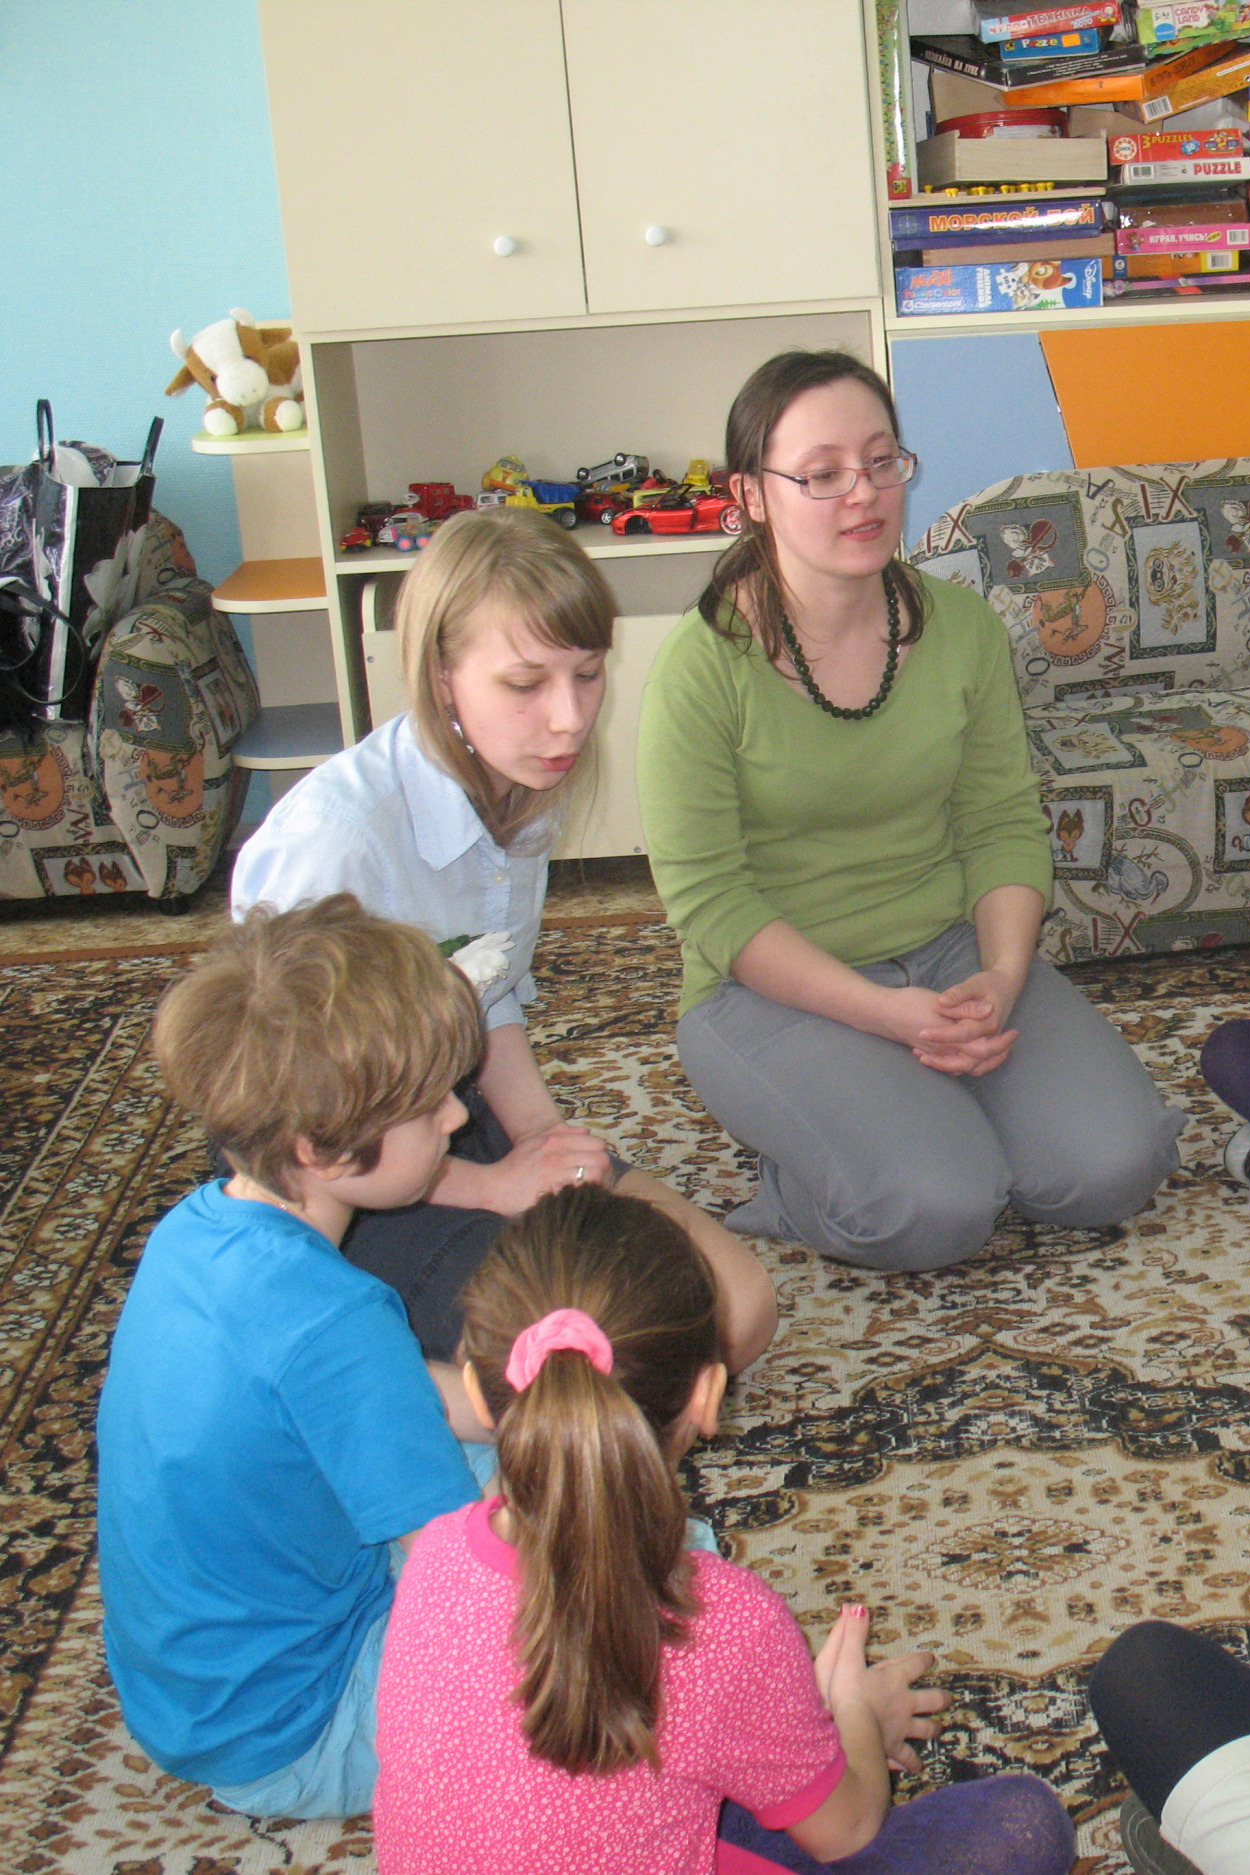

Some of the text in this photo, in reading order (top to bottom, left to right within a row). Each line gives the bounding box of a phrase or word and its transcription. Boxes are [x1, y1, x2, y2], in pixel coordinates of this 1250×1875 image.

[1174, 5, 1204, 17] CANDY
[1178, 14, 1201, 25] LAND
[1142, 135, 1151, 149] 3
[1152, 134, 1193, 144] PUZZLES
[1193, 162, 1242, 175] PUZZLE
[929, 207, 1038, 232] МОРСКОЙ
[1082, 260, 1097, 299] Disney
